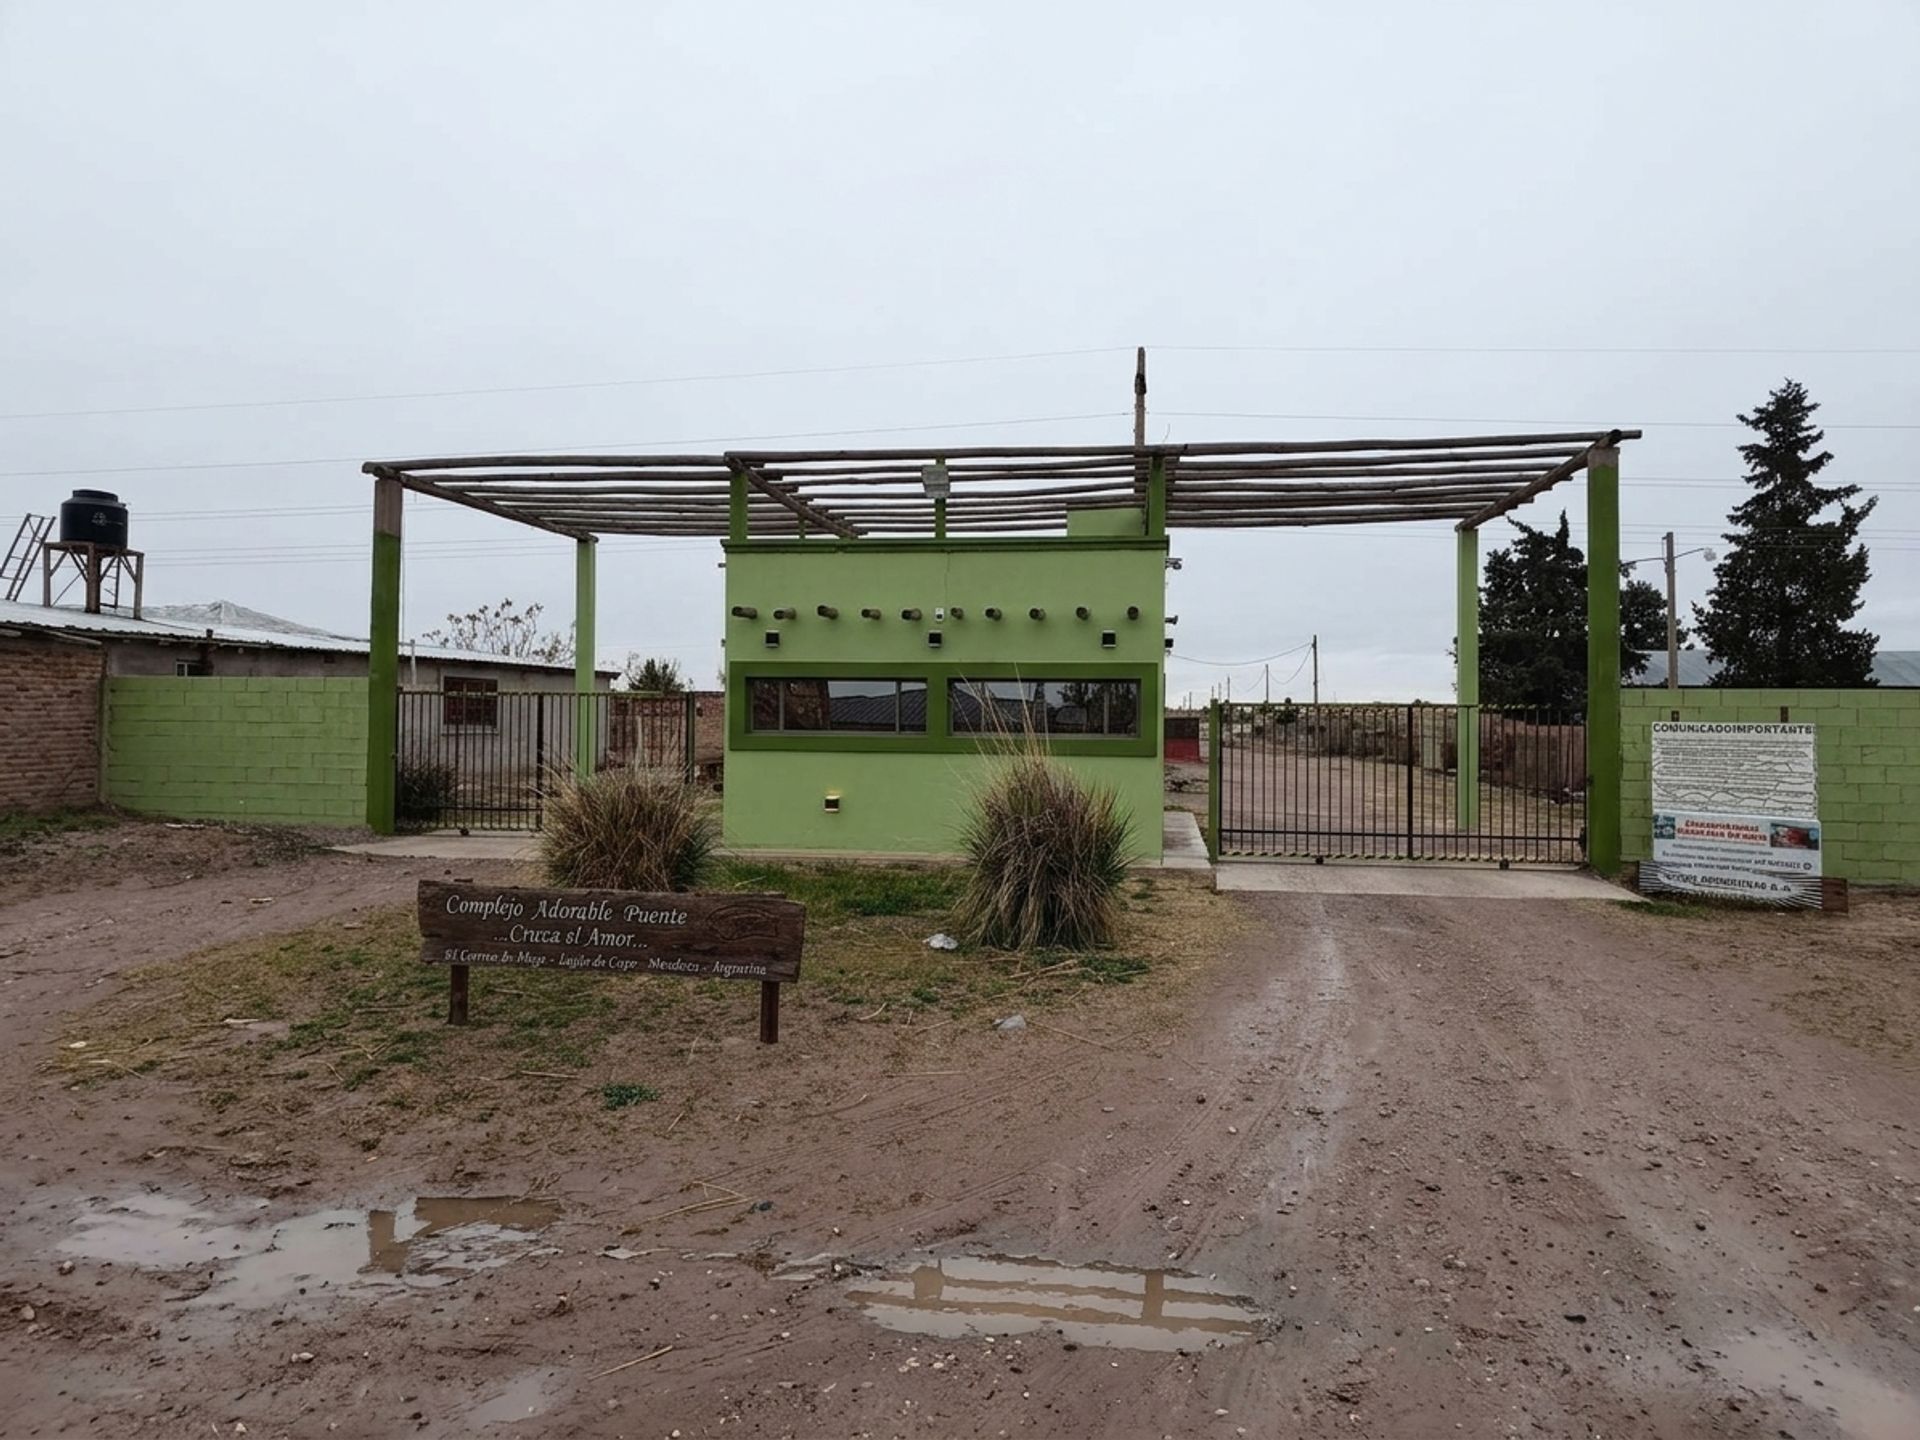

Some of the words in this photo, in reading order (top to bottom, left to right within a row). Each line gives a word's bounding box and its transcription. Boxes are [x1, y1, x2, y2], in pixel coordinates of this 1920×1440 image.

[446, 895, 524, 921] Complejo
[531, 898, 613, 921] Adorable
[623, 904, 688, 925] Puente
